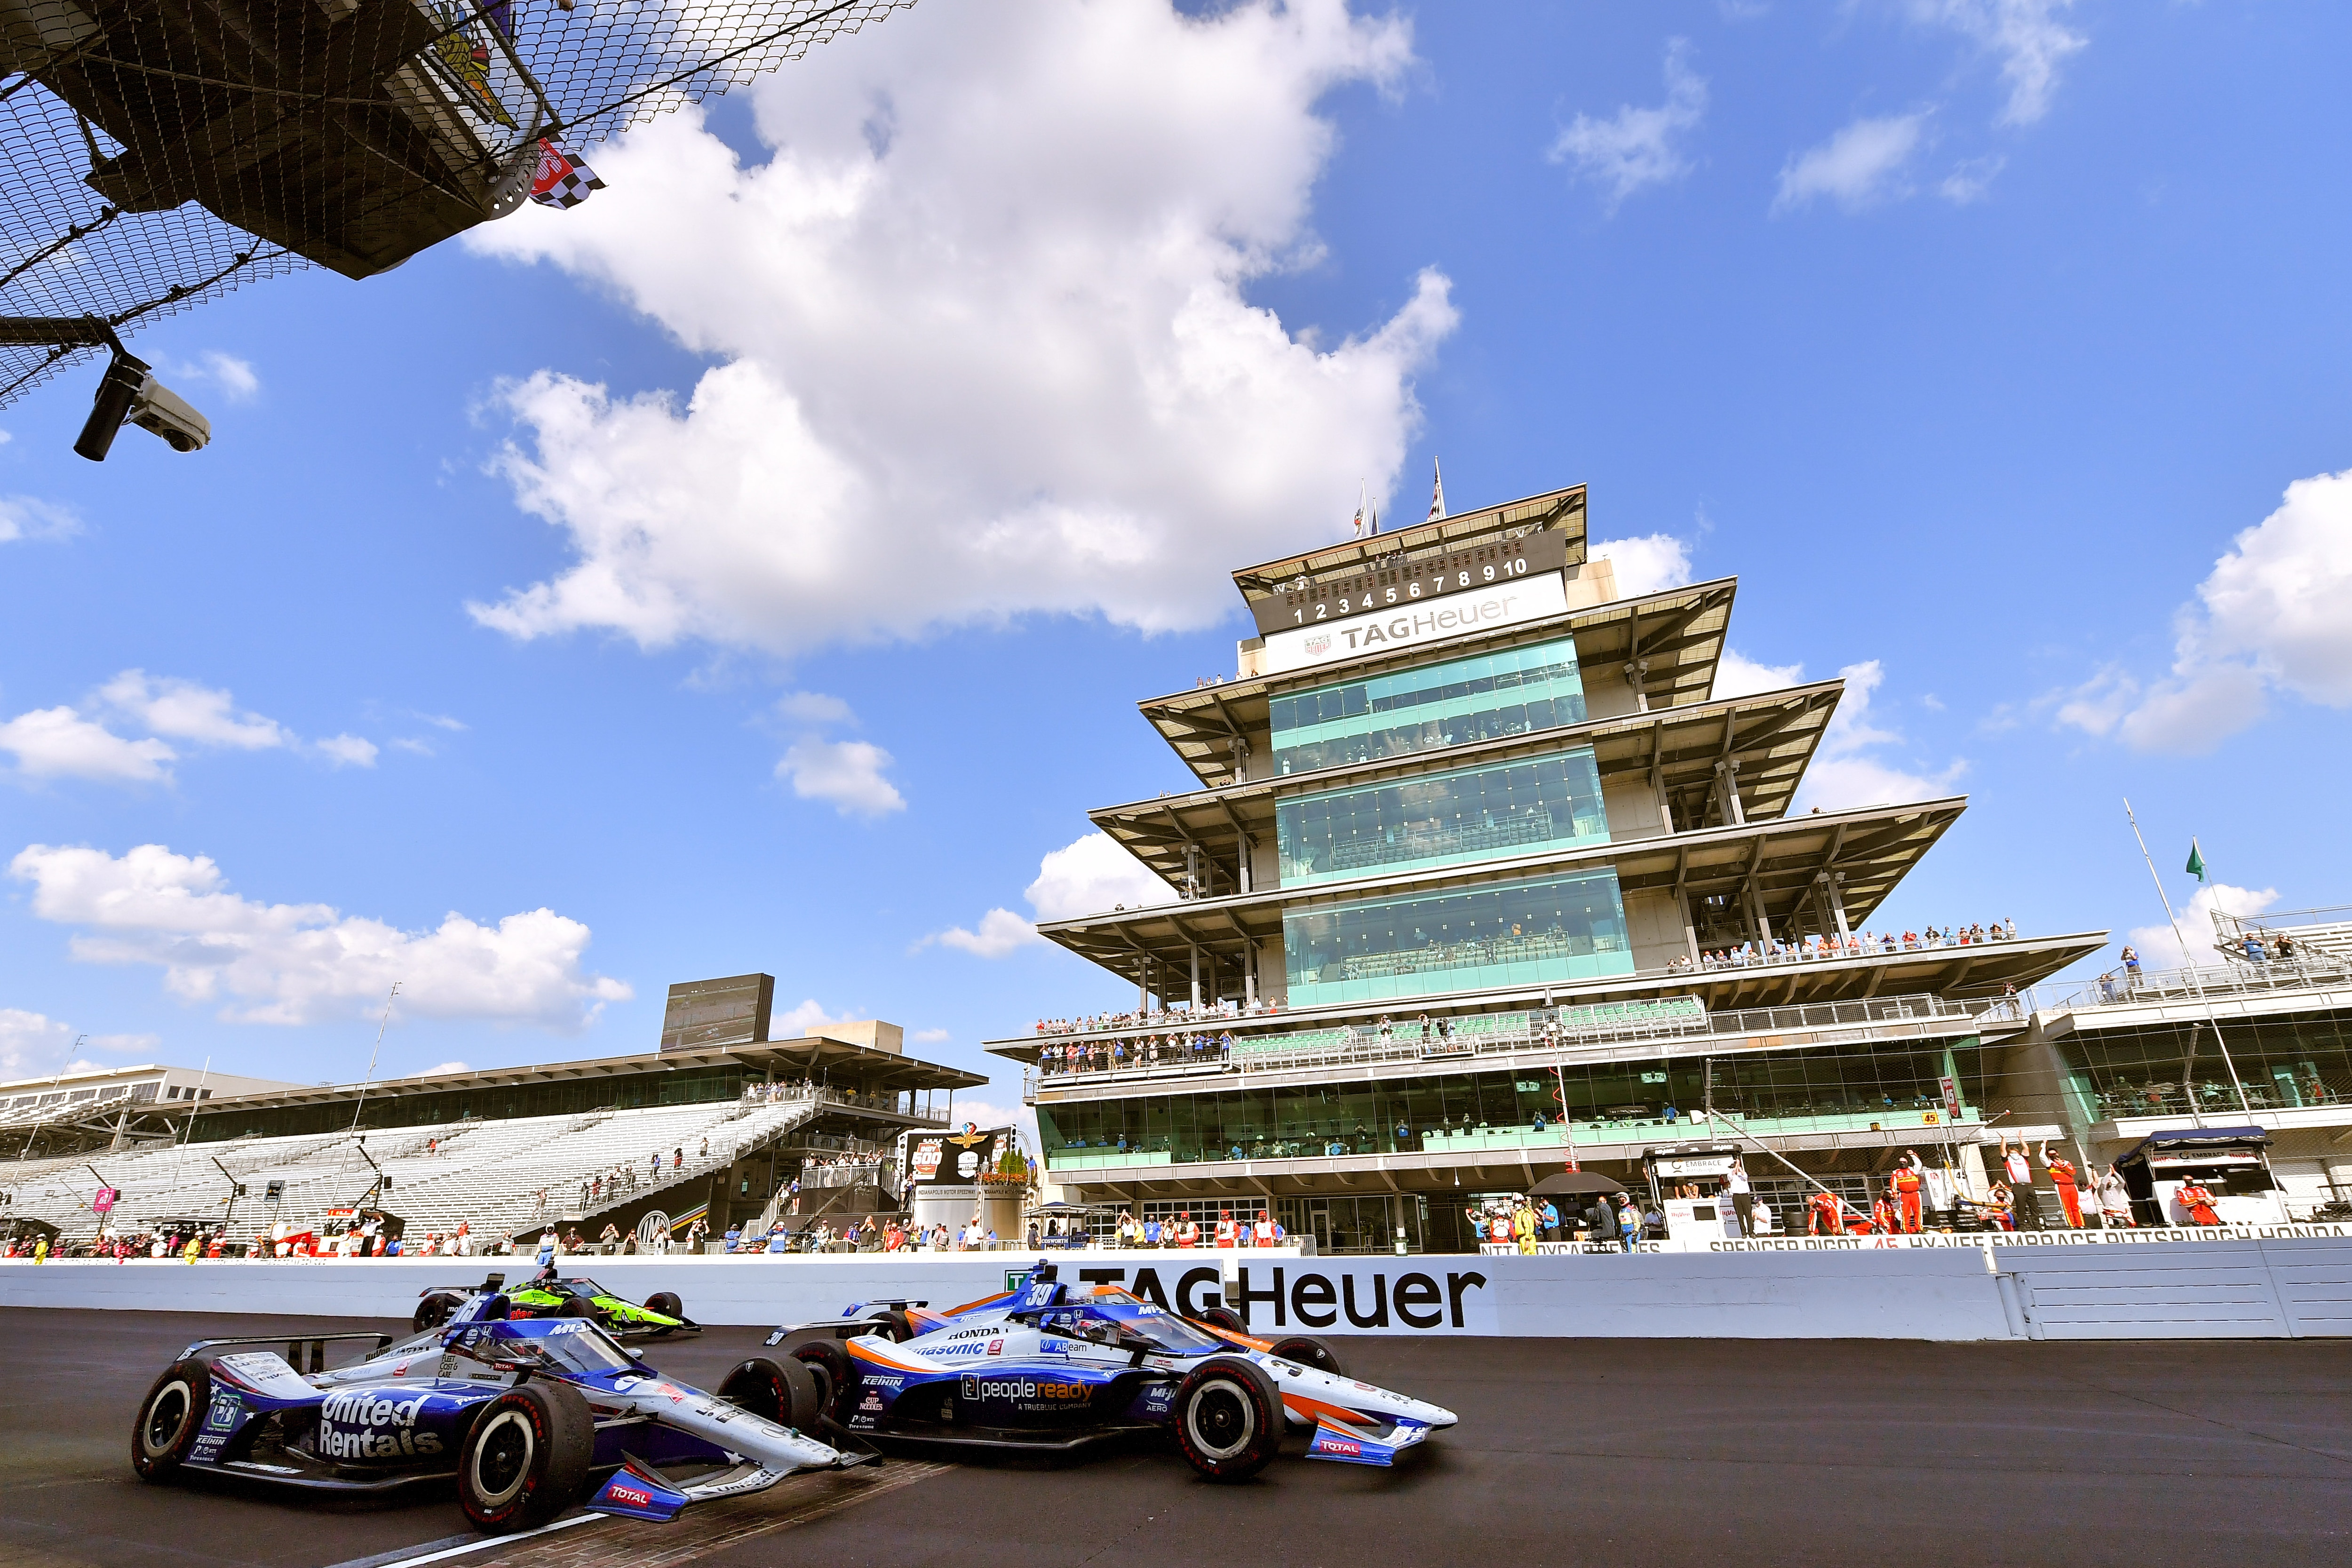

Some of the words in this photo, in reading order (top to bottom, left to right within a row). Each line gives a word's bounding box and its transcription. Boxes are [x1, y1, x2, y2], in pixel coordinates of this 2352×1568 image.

[1294, 609, 1303, 623] 1
[1315, 604, 1327, 620] 2
[1339, 598, 1350, 613] 3
[1362, 593, 1374, 608] 4
[1386, 587, 1397, 603] 5
[1409, 582, 1421, 597] 6
[1433, 576, 1445, 592] 7
[1458, 571, 1470, 587] 8
[1483, 565, 1495, 581] 9
[1503, 558, 1527, 576] 10
[1286, 591, 1306, 608] 30
[1306, 636, 1329, 645] TAG
[1306, 643, 1330, 653] HEUER
[911, 1152, 943, 1165] 500
[1481, 1245, 1512, 1256] NTT
[1025, 1283, 1055, 1306] 30
[454, 1295, 490, 1323] 15
[548, 1322, 591, 1336] MI-J
[948, 1328, 1000, 1340] HONDA
[766, 1331, 785, 1345] 30
[862, 1375, 905, 1386] KEIHIN
[982, 1377, 1094, 1403] peopleready
[322, 1391, 433, 1426] United
[1059, 1401, 1091, 1410] COMPANY
[196, 1435, 227, 1445] KEIHIN
[320, 1419, 443, 1458] Rentals
[1320, 1441, 1359, 1453] TOTAL
[612, 1485, 648, 1504] TOTAL
